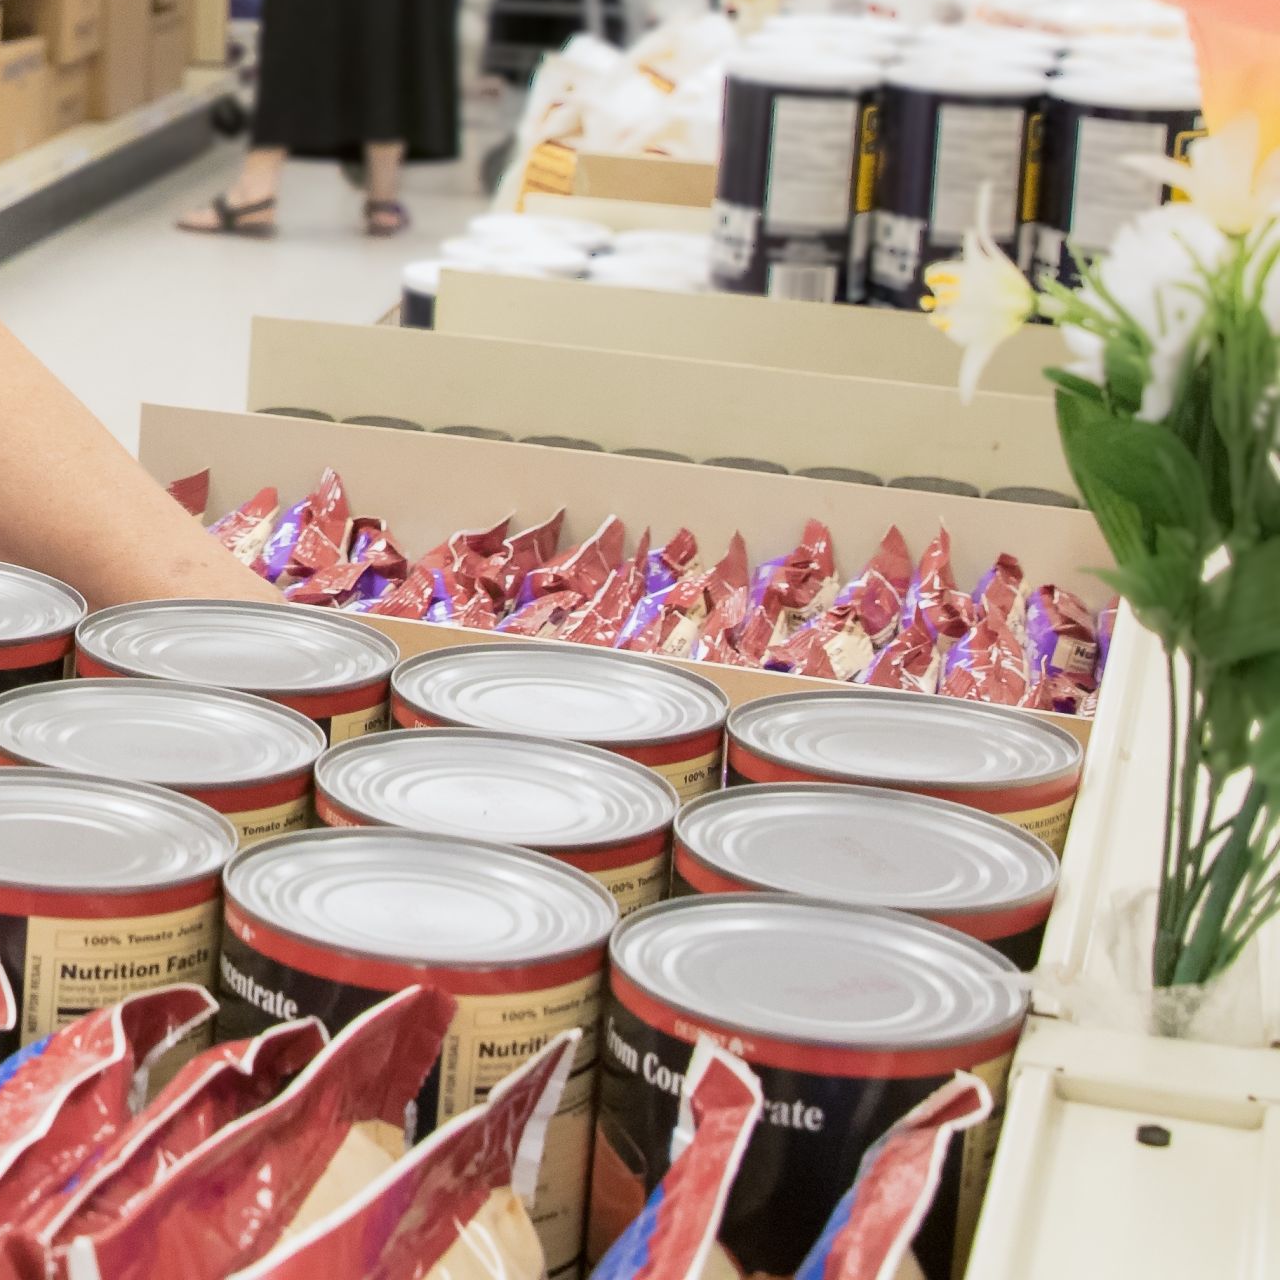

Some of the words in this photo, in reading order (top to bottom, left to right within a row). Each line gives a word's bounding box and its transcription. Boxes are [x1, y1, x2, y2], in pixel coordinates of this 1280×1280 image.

[242, 821, 281, 836] Tomato
[83, 935, 122, 948] 100%
[127, 930, 174, 945] Tomato
[177, 921, 204, 938] Juice
[60, 961, 161, 981] Nutrition
[166, 948, 209, 973] Facts
[501, 1007, 538, 1022] 100%
